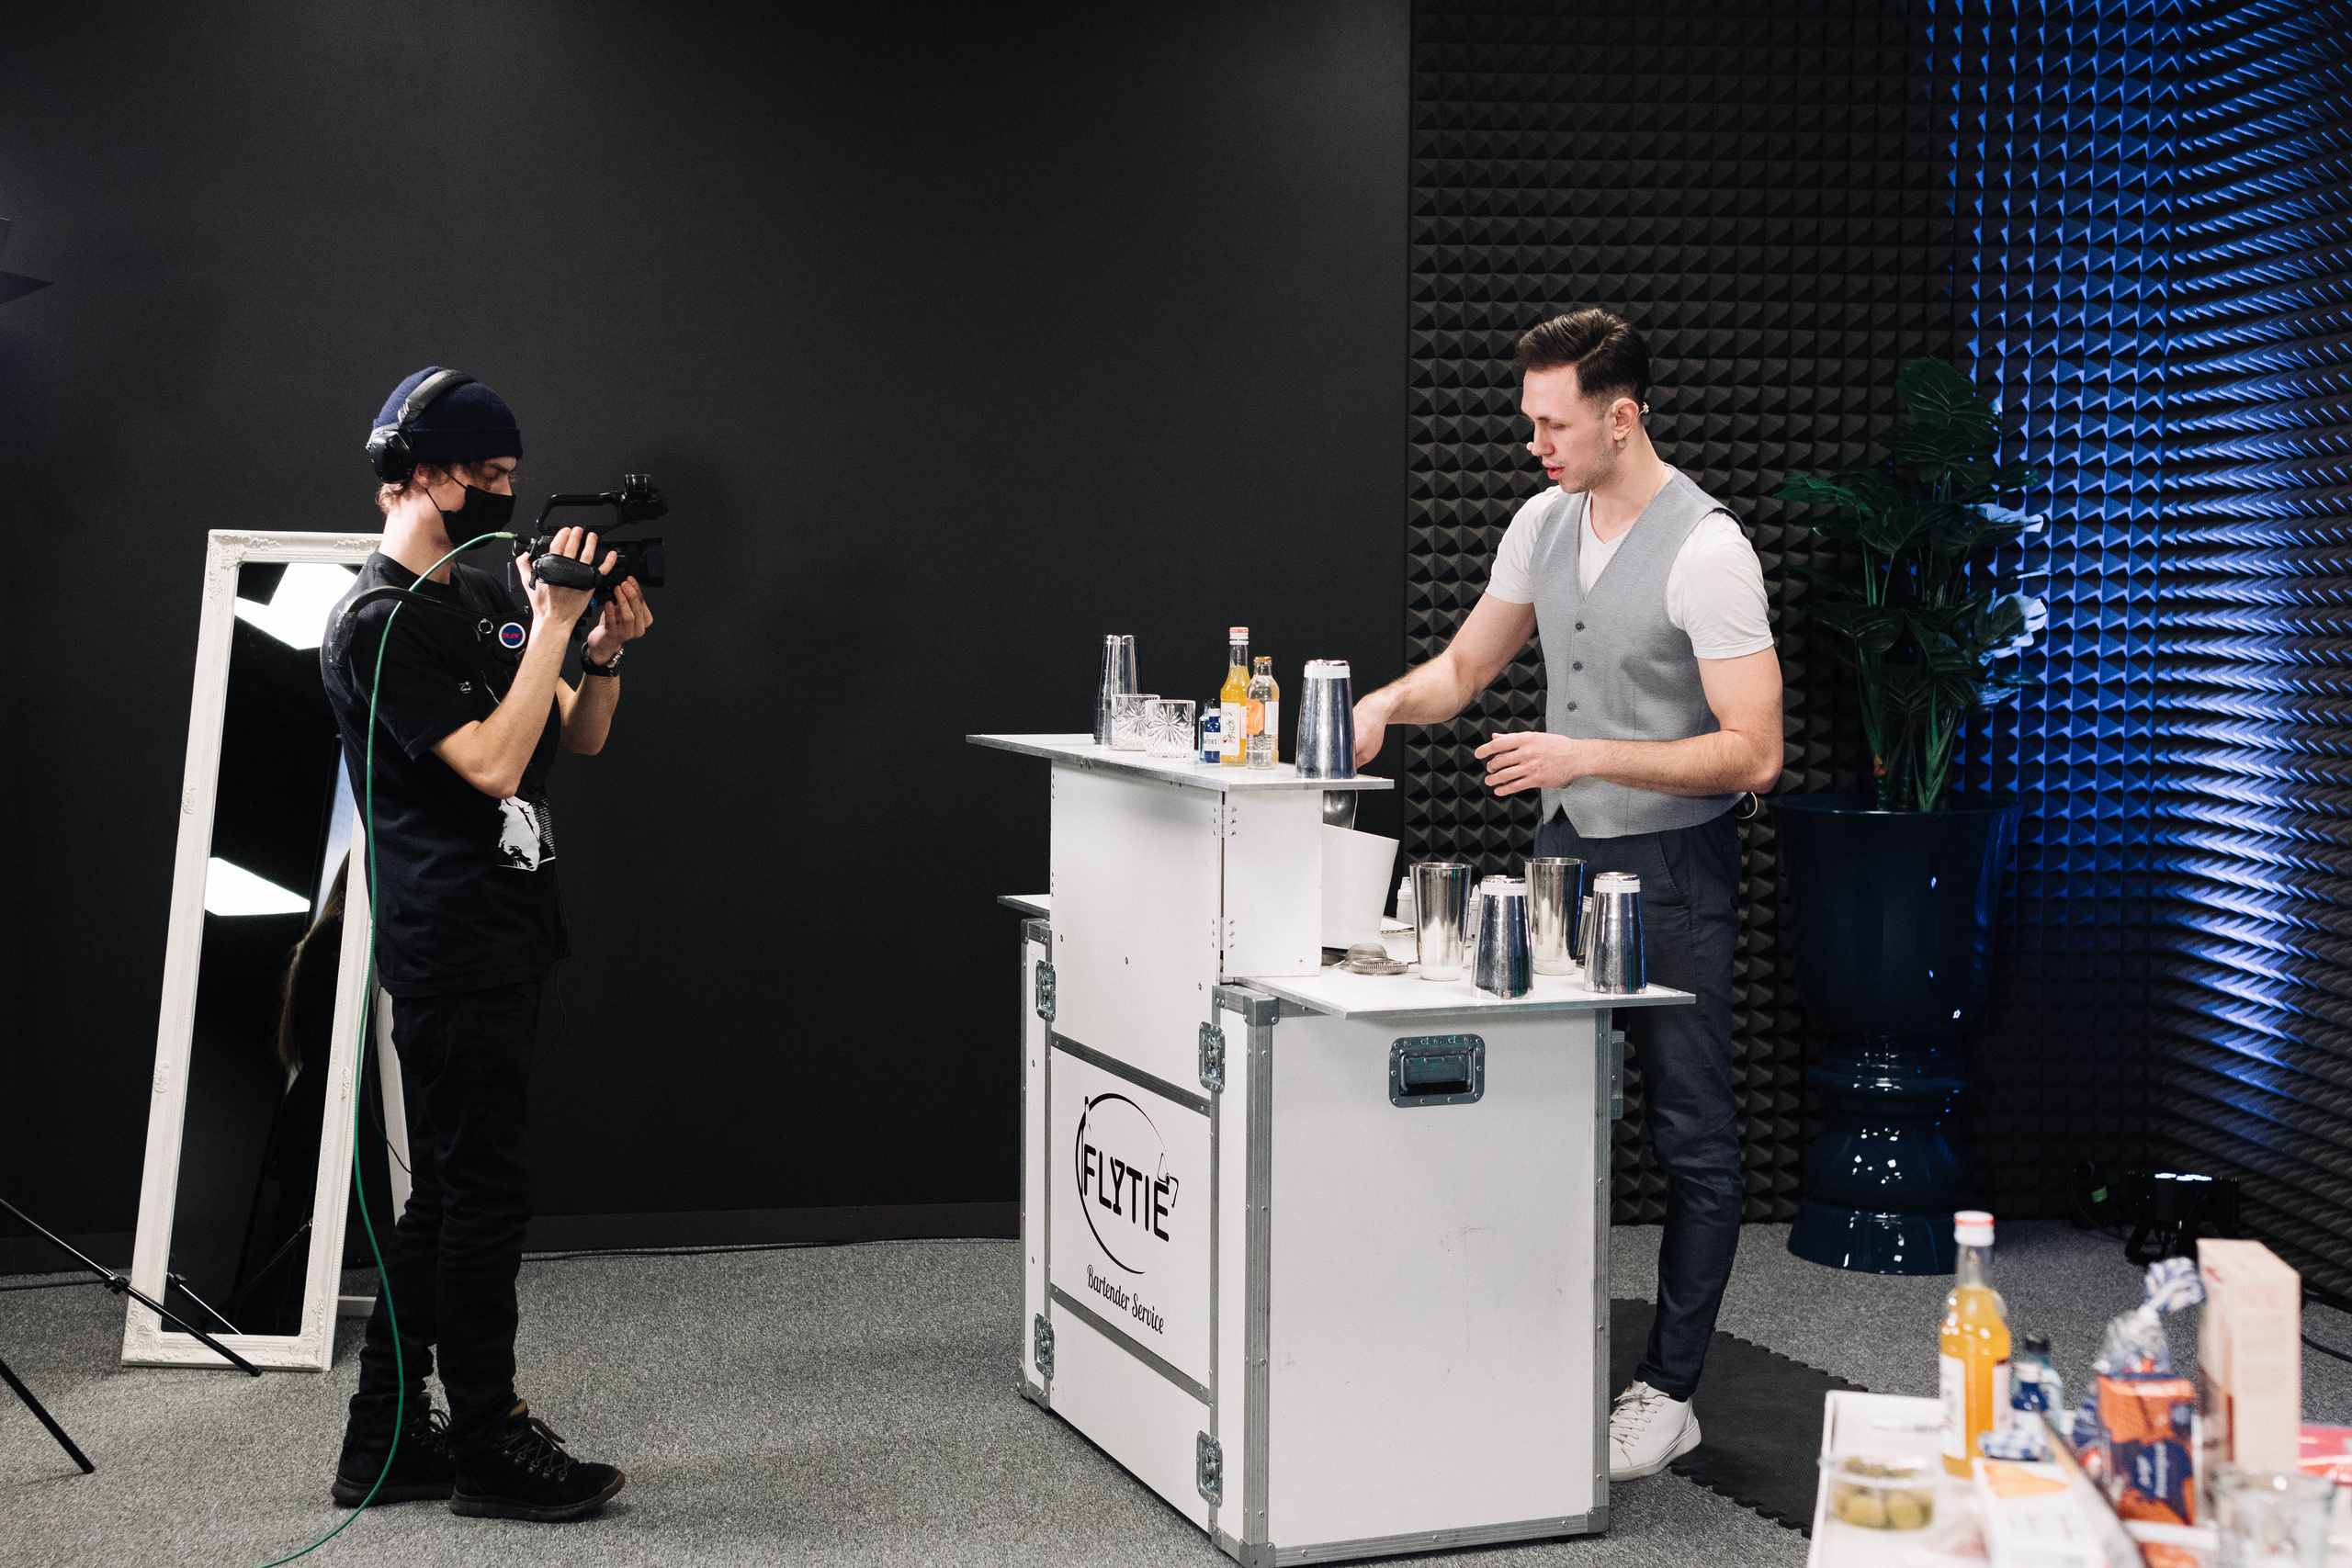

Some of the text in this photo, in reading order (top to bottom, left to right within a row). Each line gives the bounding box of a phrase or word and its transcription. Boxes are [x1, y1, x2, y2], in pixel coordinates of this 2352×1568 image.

[1083, 1143, 1170, 1242] FLYTIE
[1087, 1264, 1164, 1335] Bartender Service
